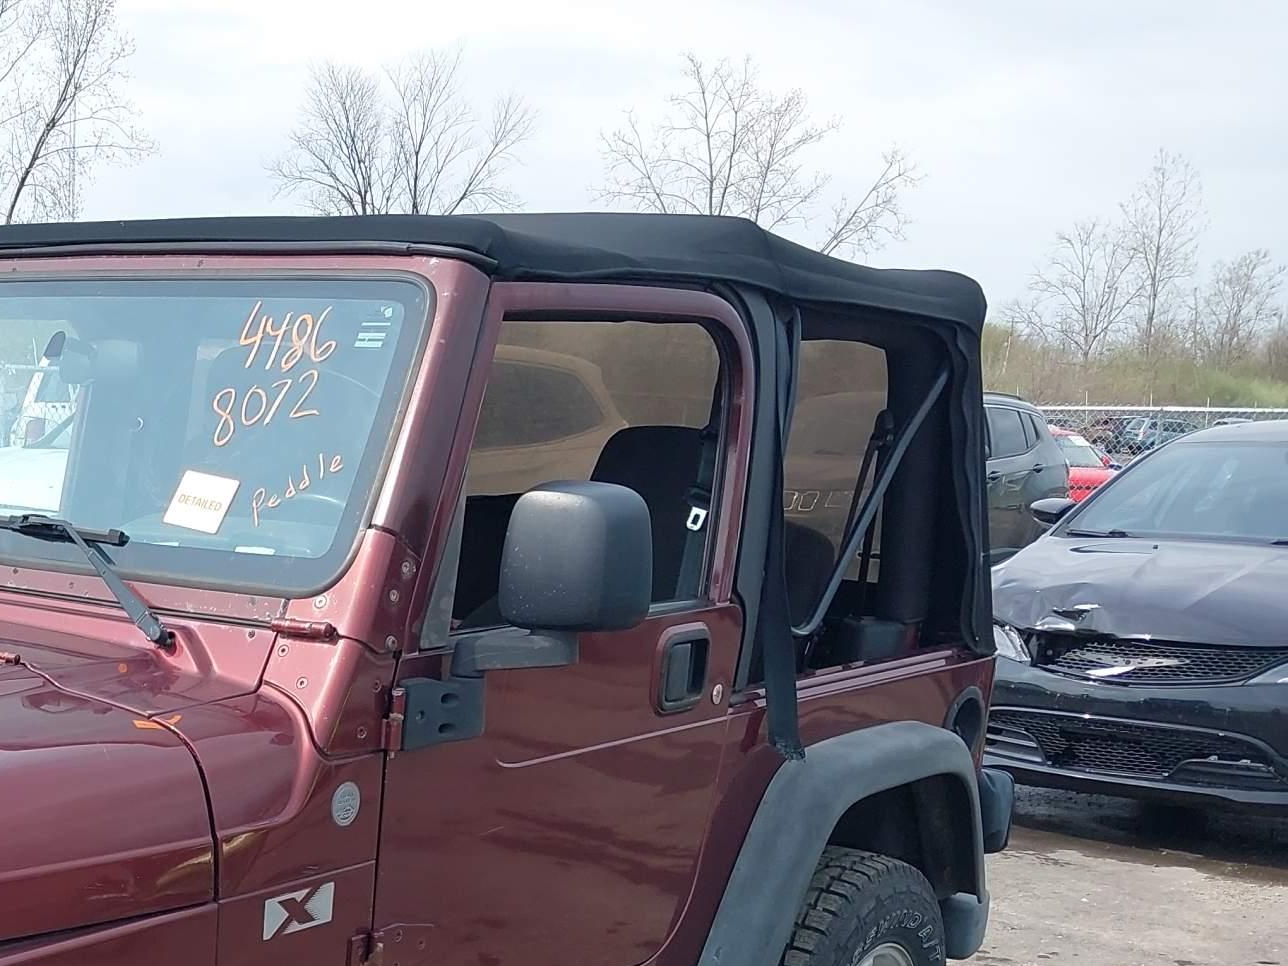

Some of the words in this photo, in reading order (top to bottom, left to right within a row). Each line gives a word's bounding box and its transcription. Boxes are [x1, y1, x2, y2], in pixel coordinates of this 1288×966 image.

[239, 300, 337, 372] 4486
[213, 369, 320, 447] 8072
[177, 493, 223, 512] DETAILED
